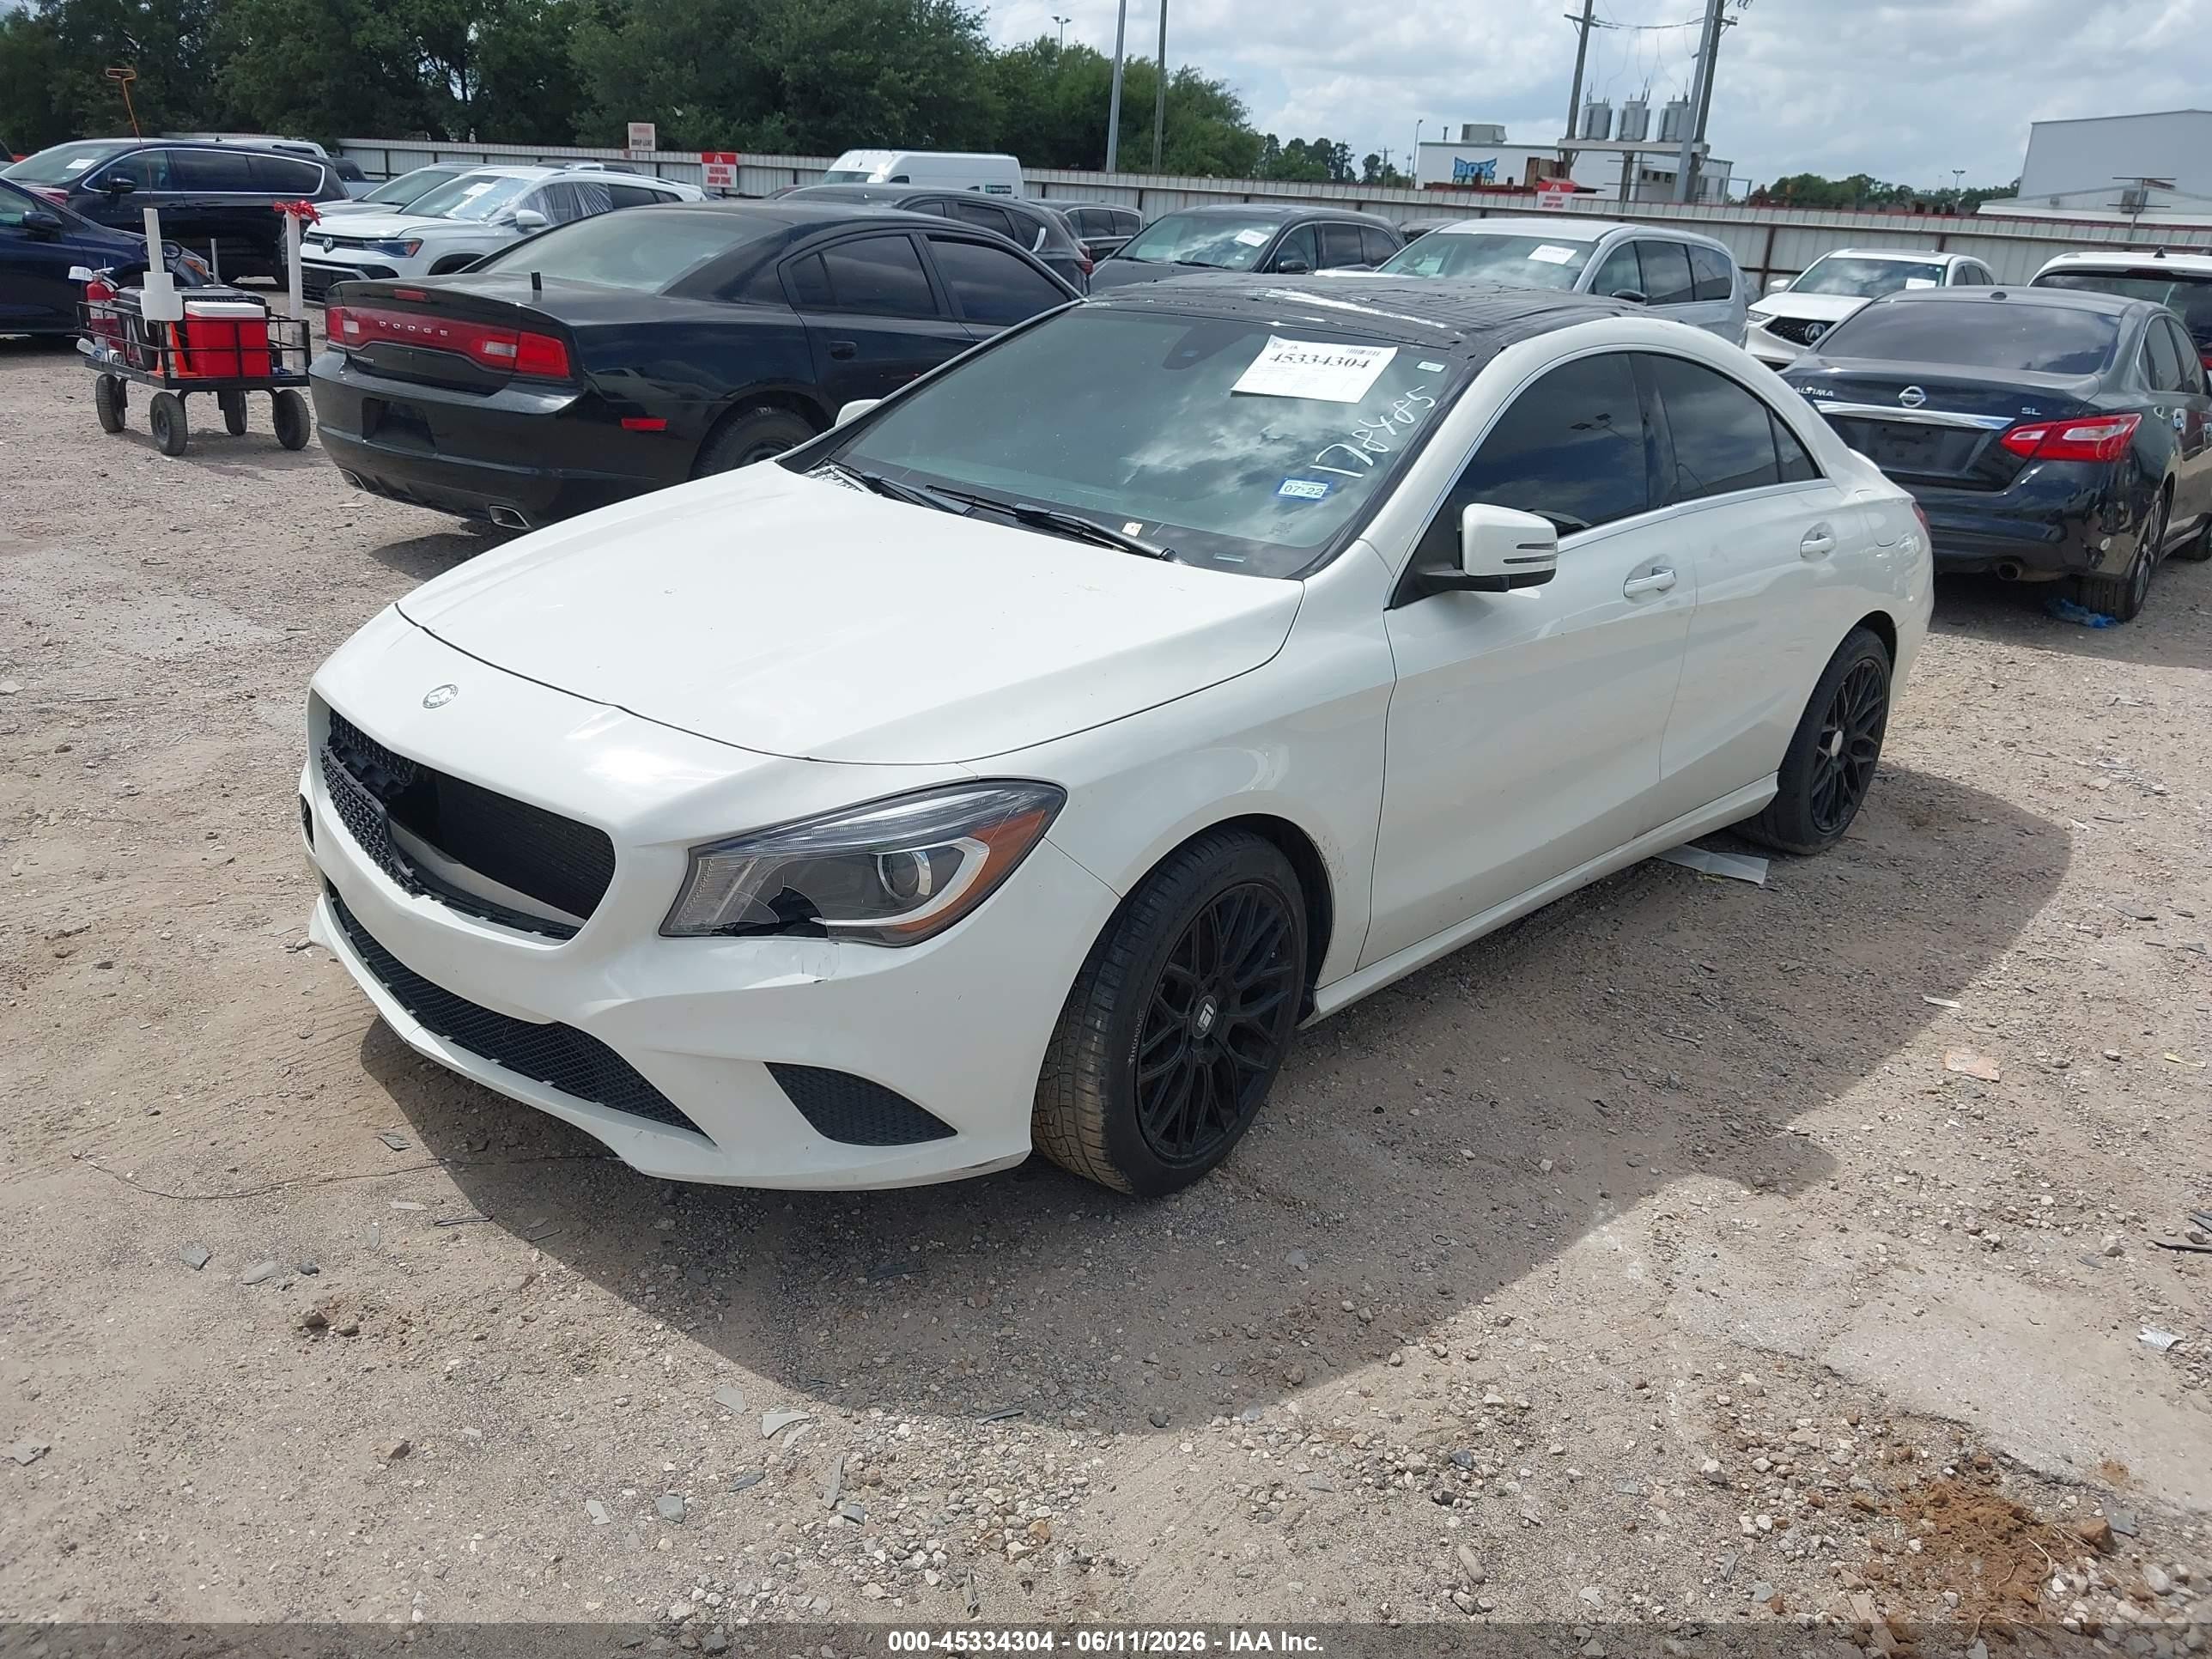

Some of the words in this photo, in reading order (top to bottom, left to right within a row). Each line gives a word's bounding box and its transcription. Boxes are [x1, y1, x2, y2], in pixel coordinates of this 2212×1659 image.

[1452, 156, 1498, 179] BOX
[379, 320, 448, 337] DODGE
[1269, 352, 1371, 369] 45334304
[2021, 406, 2042, 416] SL
